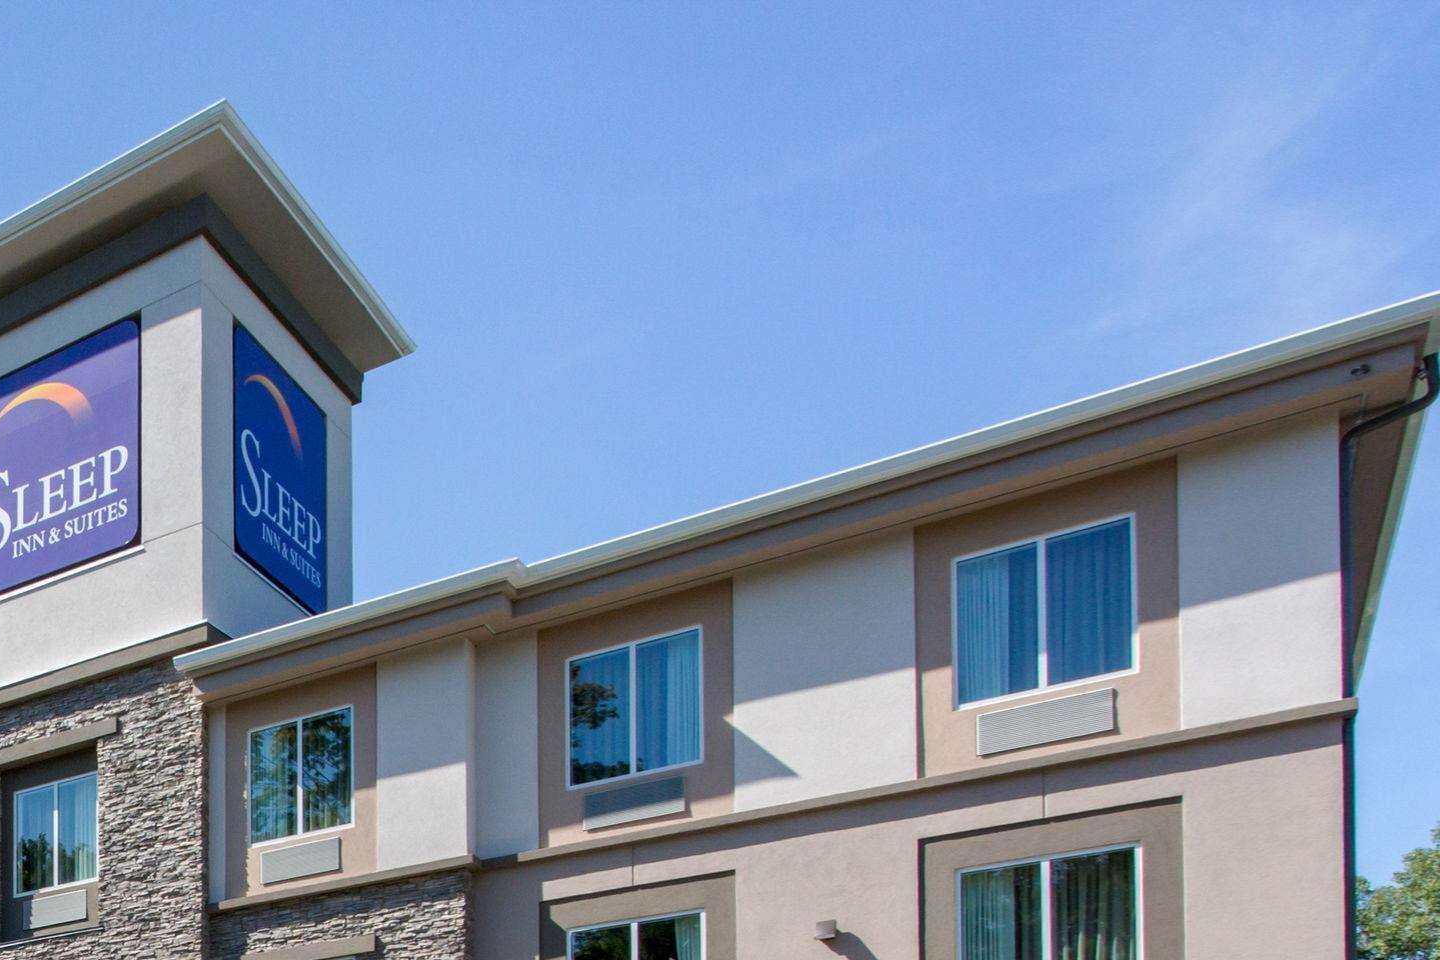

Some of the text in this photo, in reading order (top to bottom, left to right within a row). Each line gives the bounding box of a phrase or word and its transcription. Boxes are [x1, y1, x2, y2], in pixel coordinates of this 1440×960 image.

[241, 429, 321, 559] SLEEP
[12, 499, 128, 559] INN & SUITES
[262, 523, 321, 588] INN & SUITES
